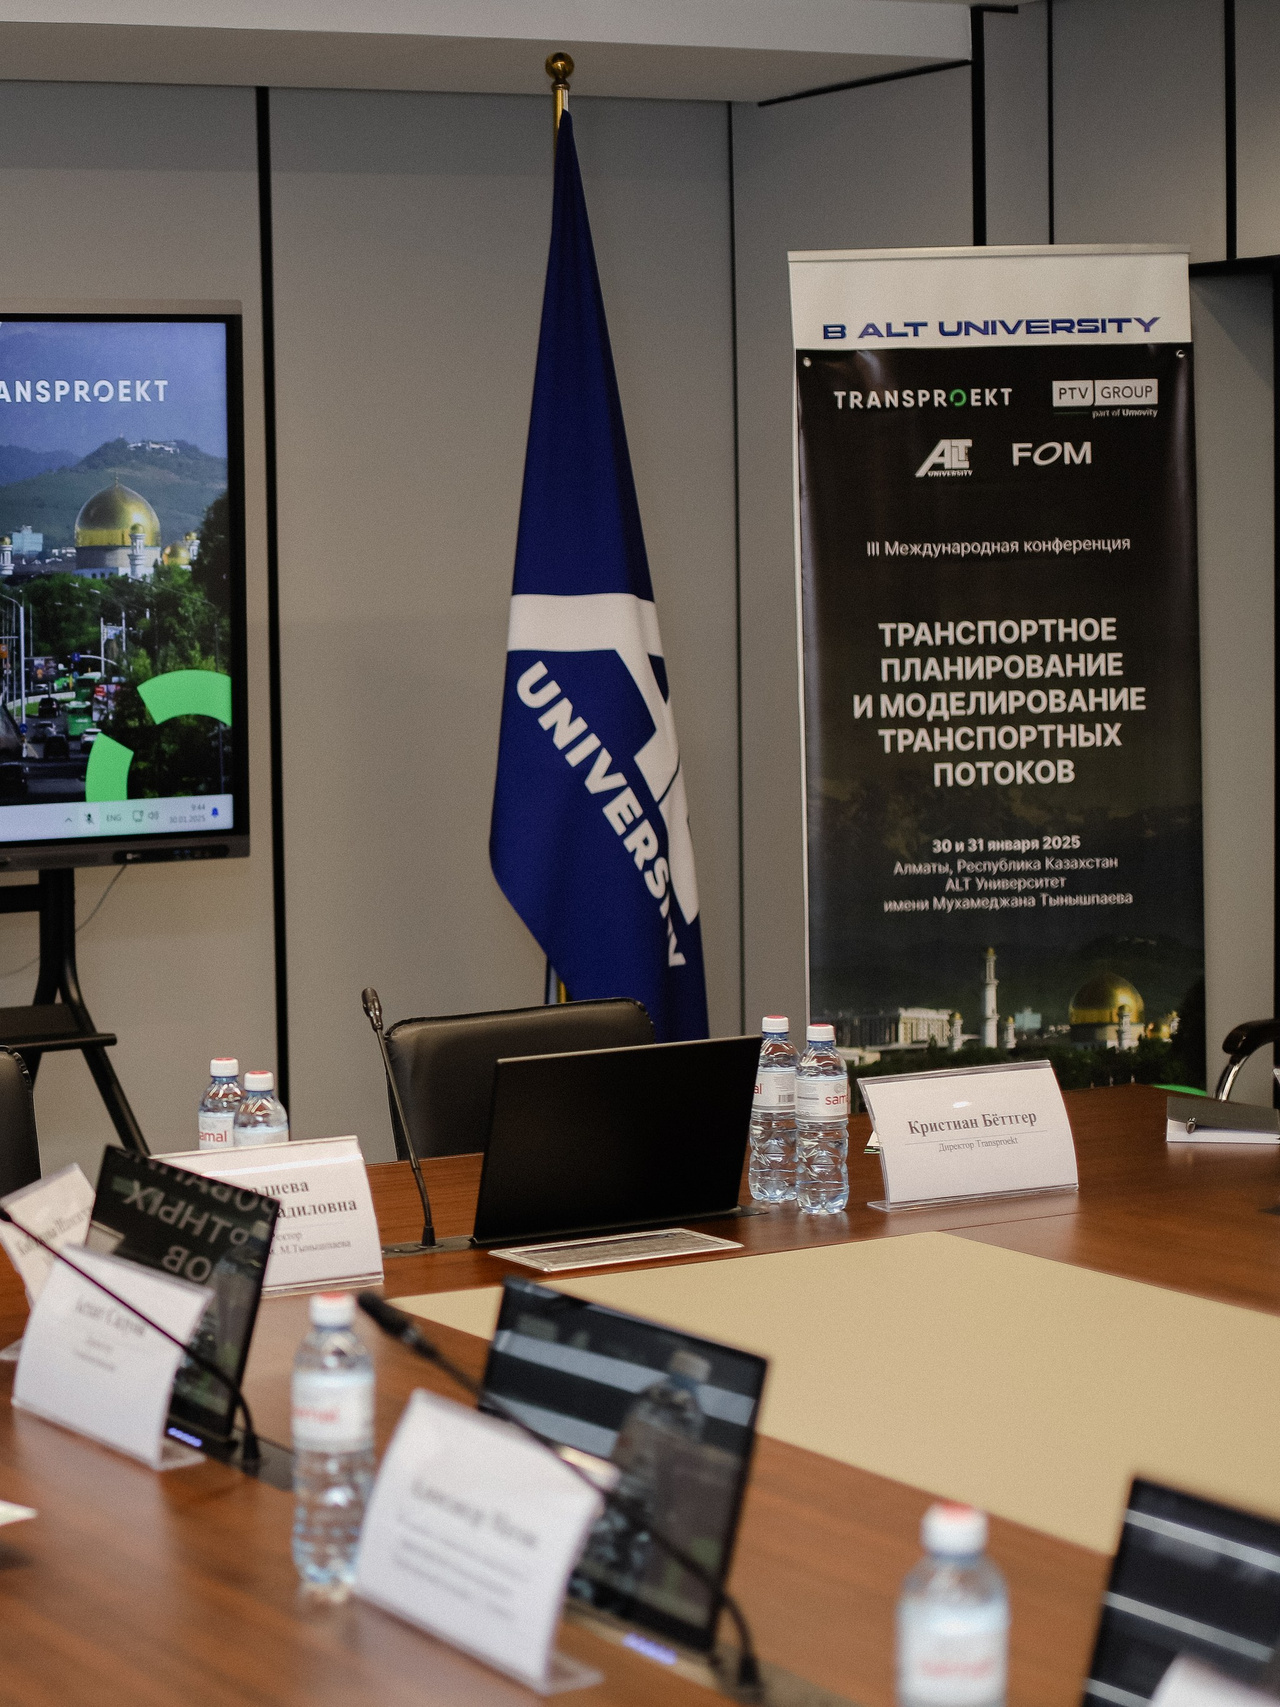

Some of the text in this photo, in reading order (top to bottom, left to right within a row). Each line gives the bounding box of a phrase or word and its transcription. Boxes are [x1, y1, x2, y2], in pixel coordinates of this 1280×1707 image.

[858, 321, 928, 339] ALT
[939, 317, 1161, 337] UNIVERSITY
[834, 387, 1013, 410] TRANSPROEKT
[1058, 386, 1089, 400] PTV
[1100, 384, 1153, 400] GROUP
[915, 439, 973, 477] ALT
[1012, 441, 1092, 466] FOM
[884, 539, 1019, 558] Международная
[1023, 537, 1131, 555] конференция
[878, 617, 1118, 647] ТРАНСПОРТНОЕ
[880, 652, 1124, 683] ПЛАНИРОВАНИЕ
[852, 687, 1147, 721] И МОДЕЛИРОВАНИЕ
[878, 722, 1122, 754] ТРАНСПОРТНЫХ
[933, 759, 1075, 787] ПОТОКОВ
[106, 814, 122, 822] ENG
[517, 660, 687, 967] UNIVERS
[932, 835, 1081, 854] 30 и 31 января 2025
[893, 855, 1119, 876] Алматы, Республика Казахстан
[944, 875, 1066, 893] ALT Университет
[883, 891, 1134, 914] имени Мухамеджана Тынышпаева
[825, 1095, 848, 1106] sam
[907, 1111, 1038, 1138] Кристиан Бёттгер
[199, 1130, 227, 1142] amal
[938, 1136, 1019, 1153] Директор Transproekt
